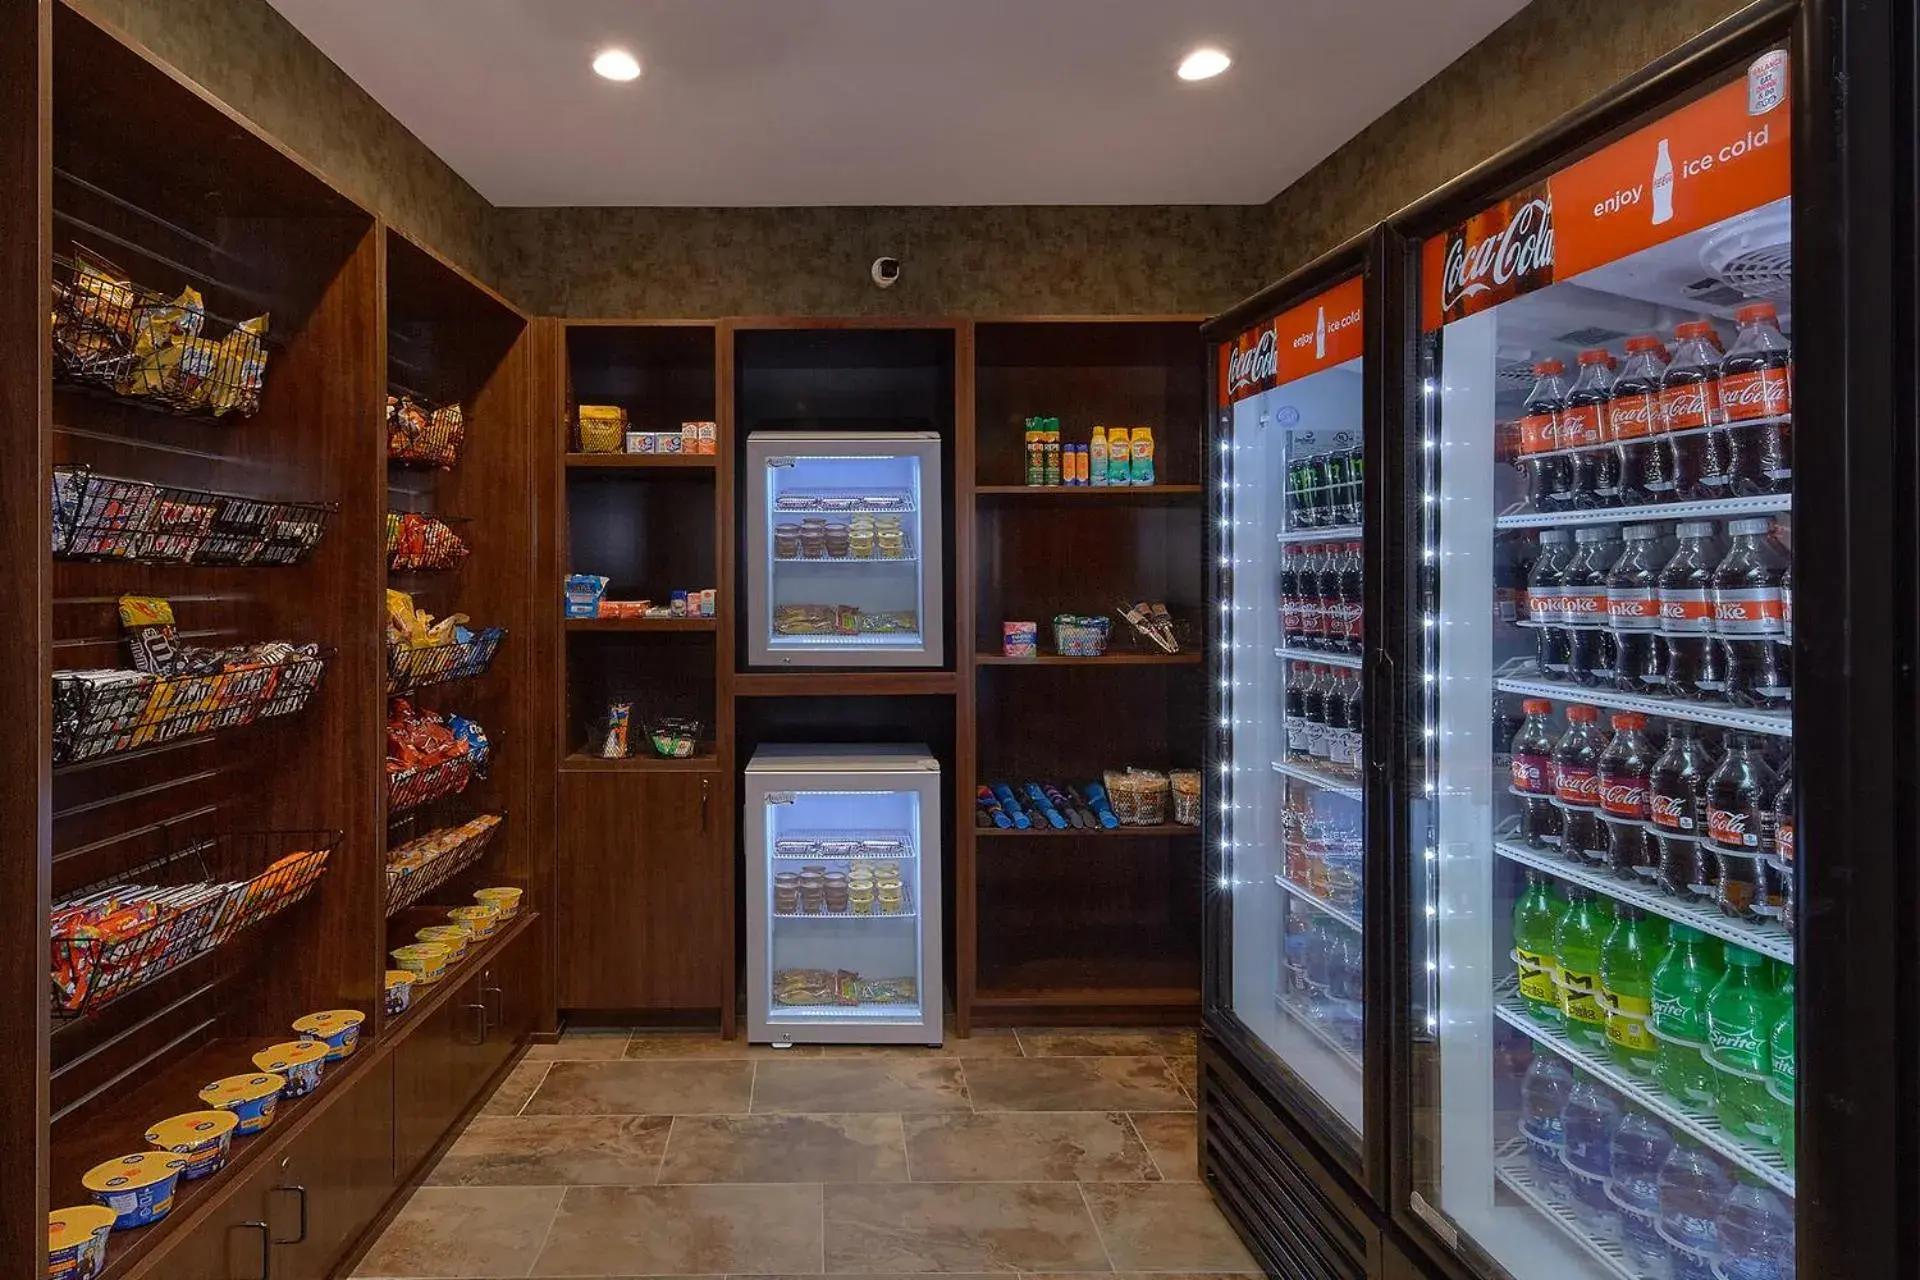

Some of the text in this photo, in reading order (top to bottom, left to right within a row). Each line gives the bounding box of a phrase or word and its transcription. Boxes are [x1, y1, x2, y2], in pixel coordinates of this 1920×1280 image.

[1682, 124, 1769, 179] ice cold
[1593, 184, 1643, 218] enjoy
[1340, 308, 1361, 328] cold
[1293, 331, 1314, 348] enjoy
[1711, 1031, 1757, 1050] Sprite
